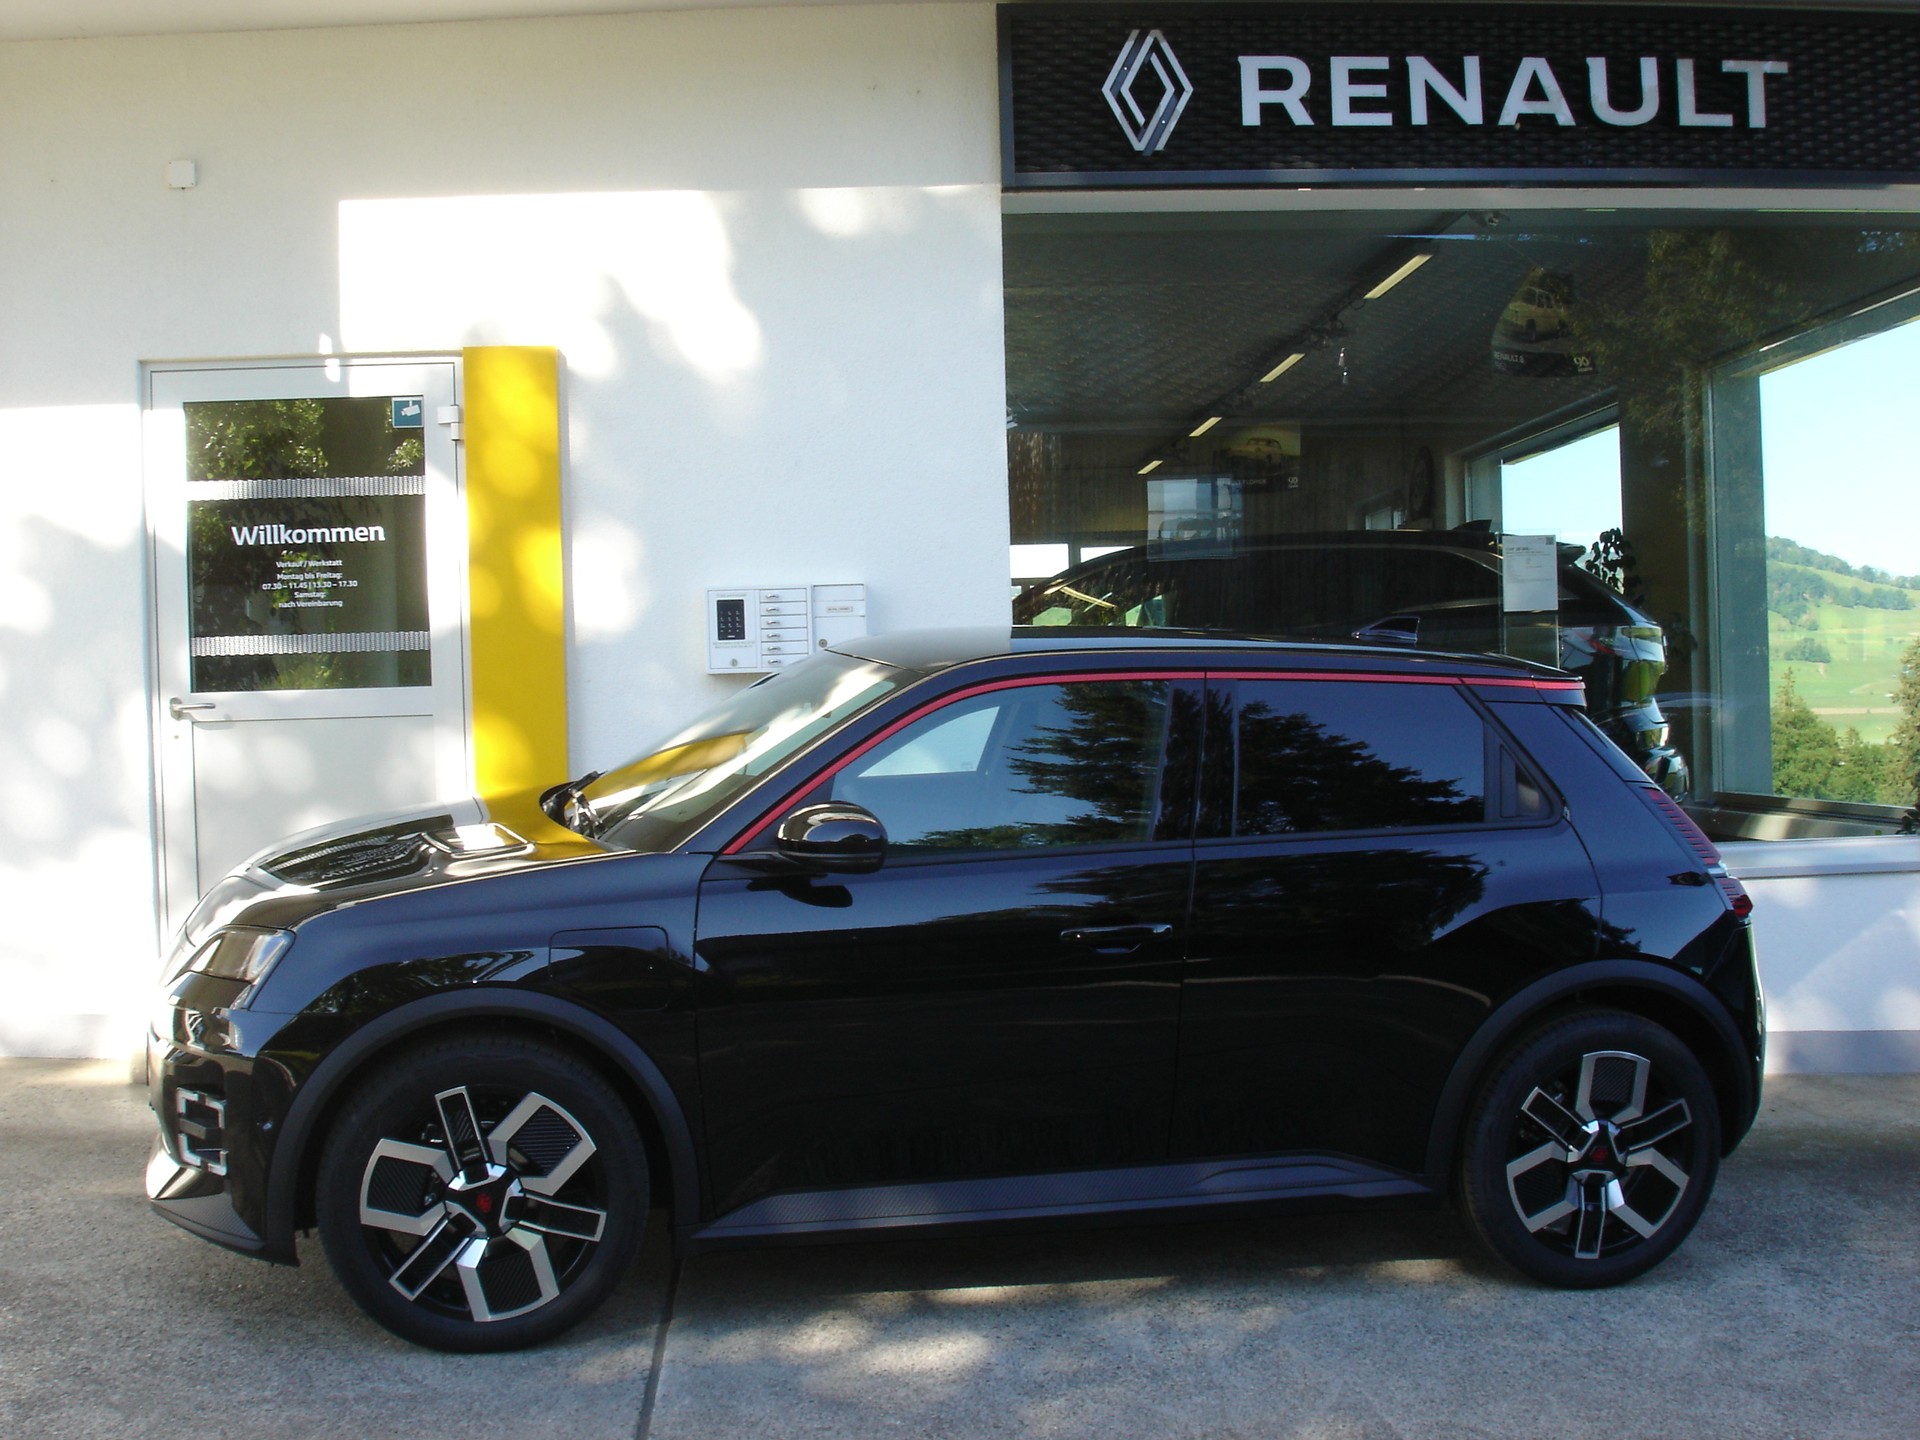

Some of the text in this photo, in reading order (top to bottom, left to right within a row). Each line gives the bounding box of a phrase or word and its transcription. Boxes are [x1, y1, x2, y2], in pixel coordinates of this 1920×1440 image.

[1238, 54, 1789, 129] RENAULT
[231, 524, 386, 546] Willkommen
[308, 559, 344, 567] Werkstatt
[277, 573, 304, 581] Montag
[316, 571, 343, 580] Freitag:
[294, 591, 327, 599] Samstag:
[296, 600, 343, 608] Vereinbarung
